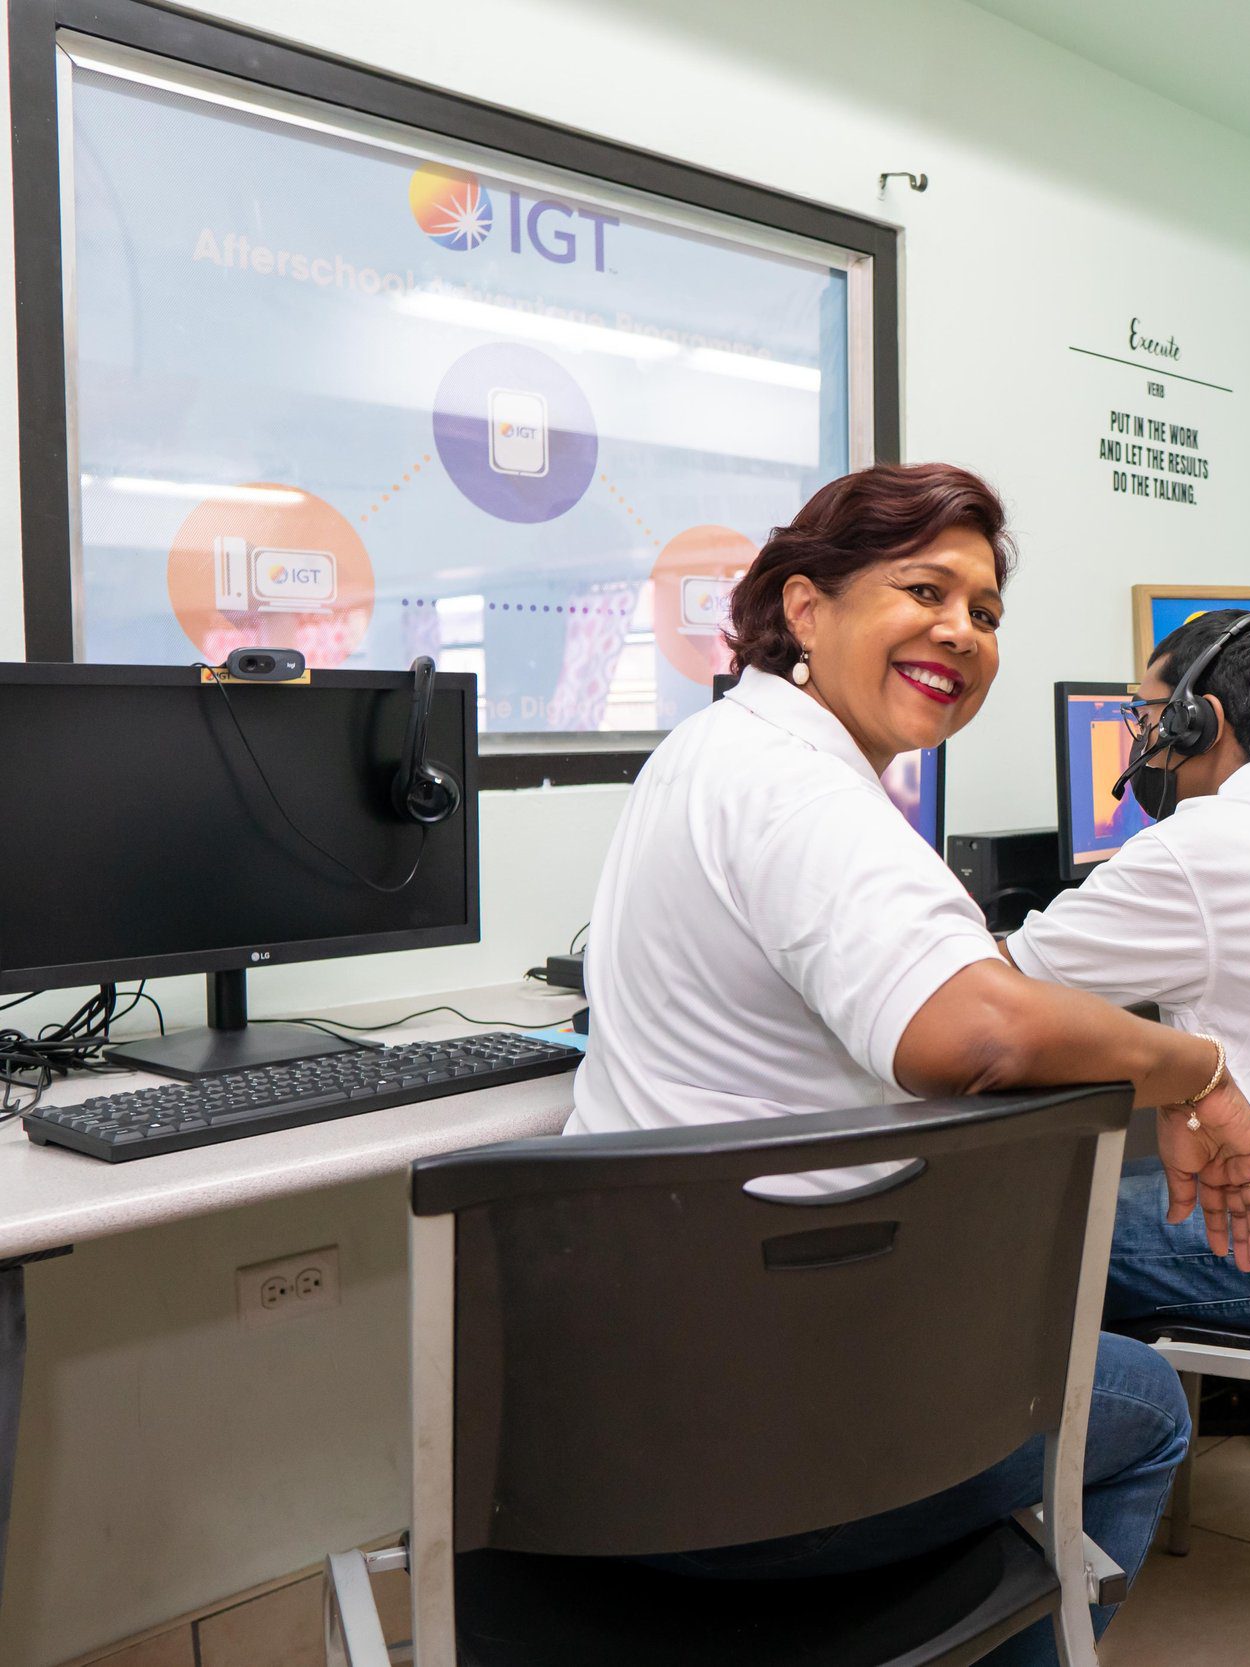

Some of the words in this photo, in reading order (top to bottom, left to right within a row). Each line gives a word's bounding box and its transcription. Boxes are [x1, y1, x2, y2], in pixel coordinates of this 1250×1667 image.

[510, 190, 620, 273] IGT
[192, 228, 415, 295] Afterschool
[1129, 317, 1182, 361] Execute
[1147, 381, 1165, 398] VERB
[516, 426, 537, 440] IGT
[1110, 411, 1130, 434] PUT
[1134, 415, 1144, 438] IN
[1147, 419, 1166, 443] THE
[1169, 424, 1199, 449] WORK
[1100, 438, 1121, 462] AND
[1125, 443, 1142, 466] LET
[1147, 448, 1164, 471] THE
[1168, 452, 1209, 479] RESULTS
[1113, 470, 1127, 493] DO
[1131, 473, 1149, 497] THE
[1153, 478, 1197, 505] TALKING.
[292, 568, 322, 584] IGT
[260, 951, 270, 960] LG
